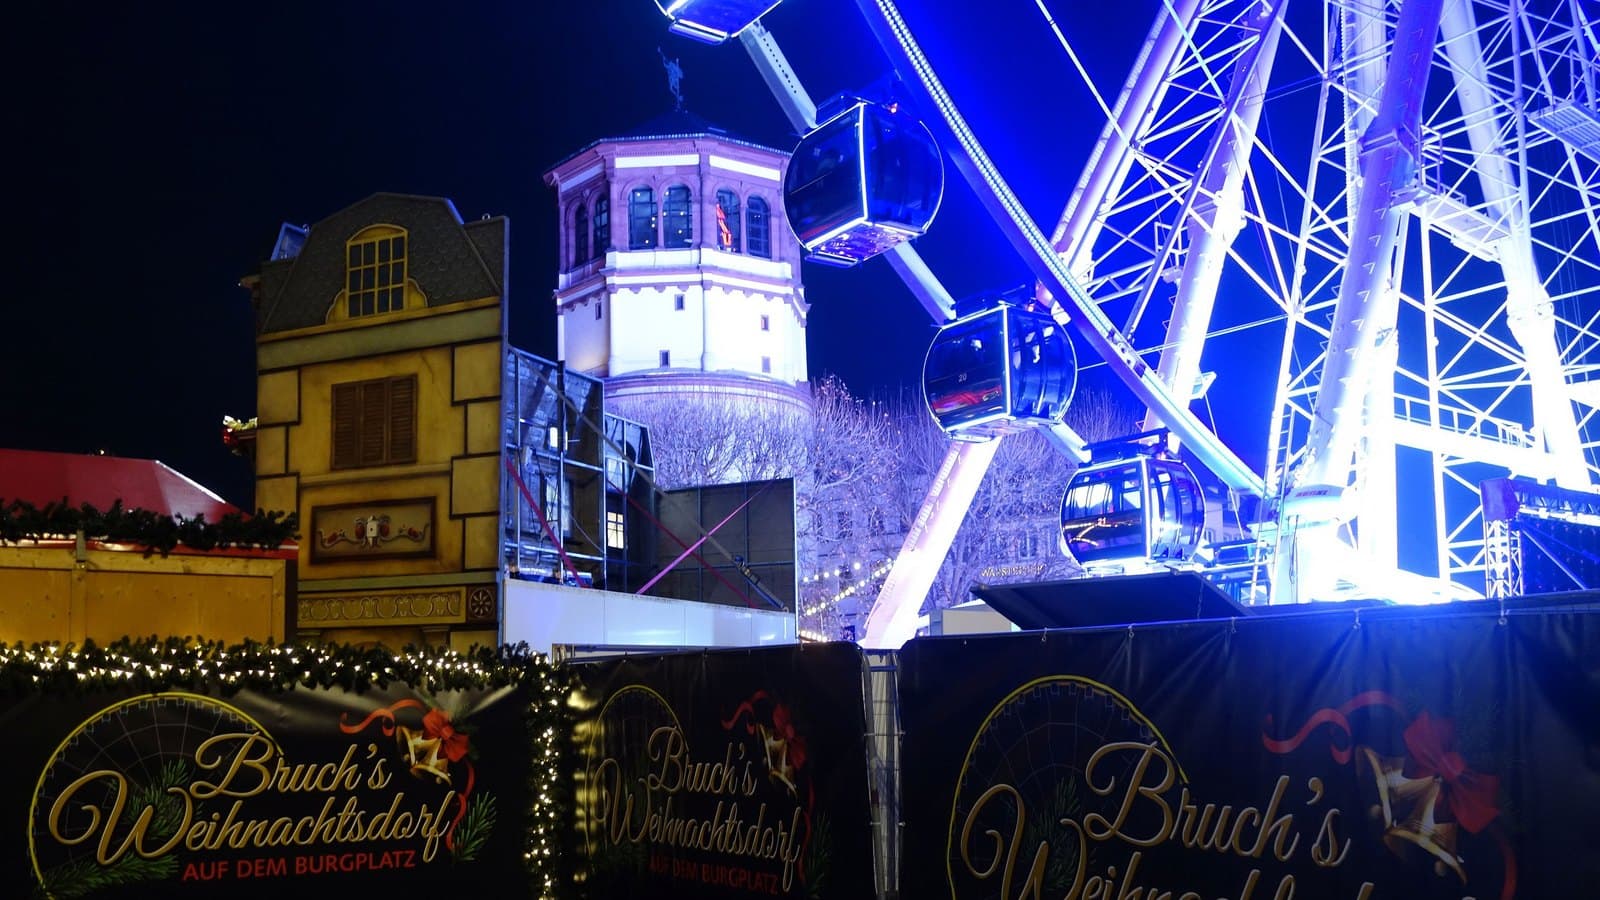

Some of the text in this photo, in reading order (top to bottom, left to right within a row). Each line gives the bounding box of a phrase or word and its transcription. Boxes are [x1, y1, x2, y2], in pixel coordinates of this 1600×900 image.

[190, 732, 392, 799] Bruch's
[648, 726, 757, 796] Bruch's
[48, 770, 455, 866] Weihnachtsdorf
[592, 758, 801, 893] Weihnachtsdorf
[1083, 740, 1351, 866] Bruch's
[182, 850, 416, 882] AUF DEM BURGPLATZ
[701, 862, 779, 896] BURGPLATZ
